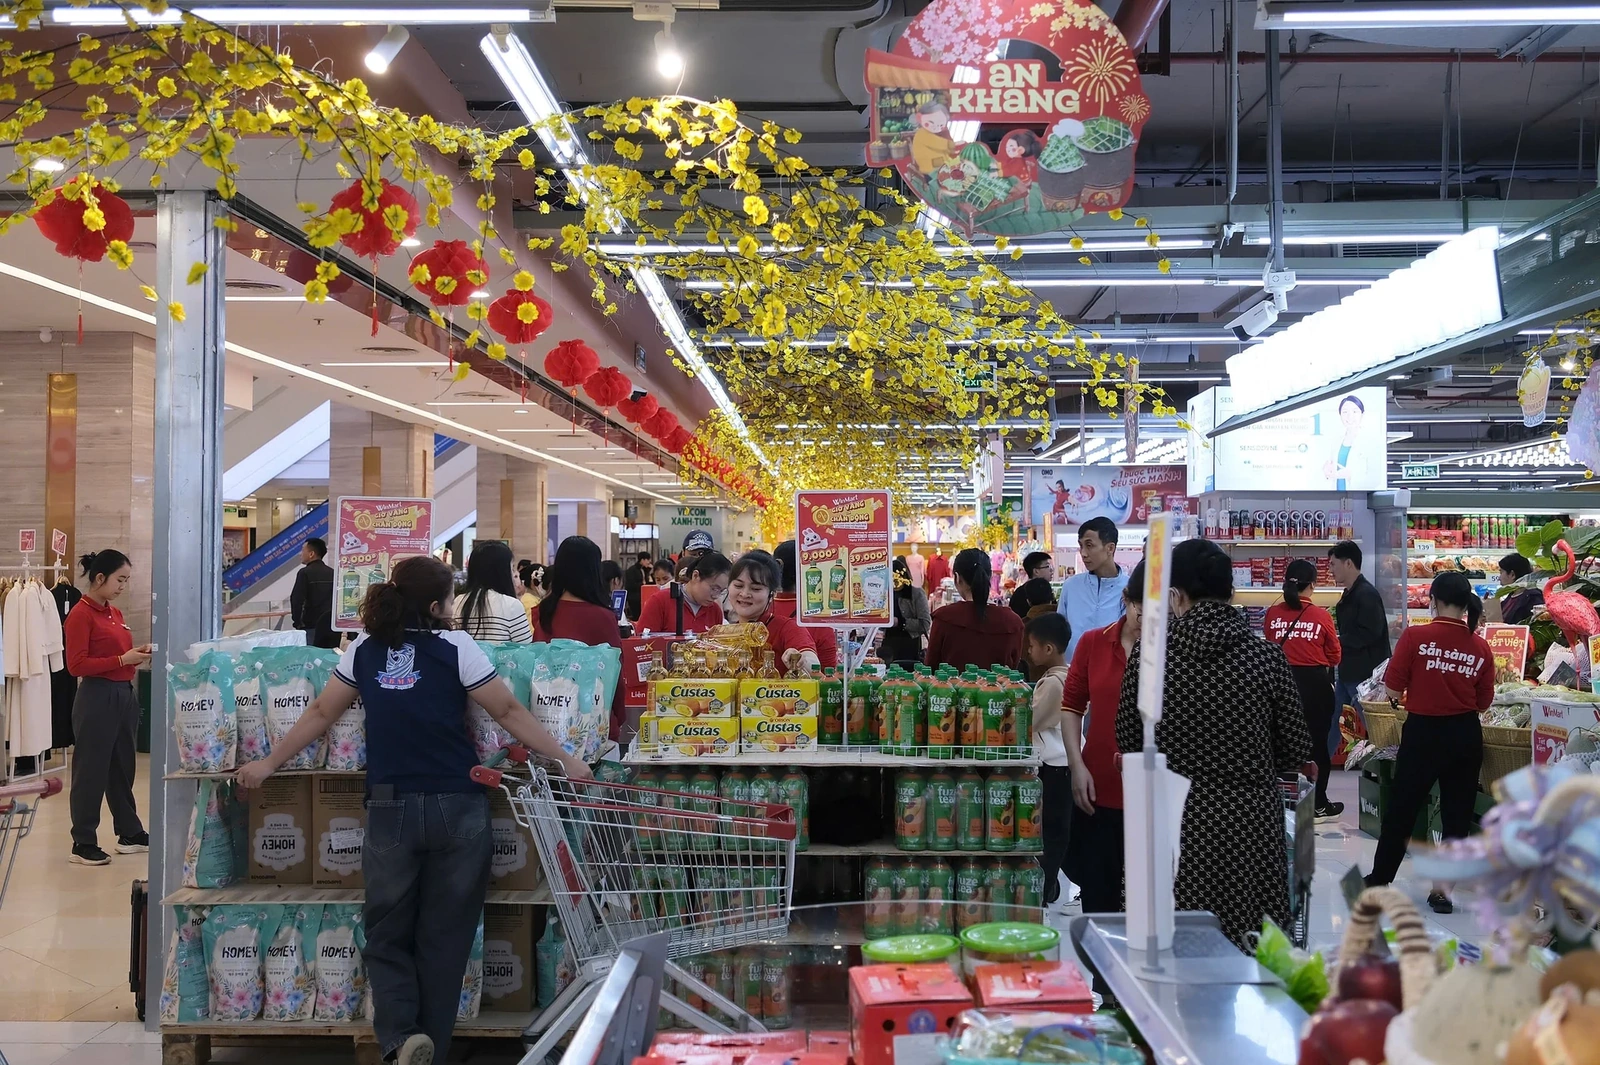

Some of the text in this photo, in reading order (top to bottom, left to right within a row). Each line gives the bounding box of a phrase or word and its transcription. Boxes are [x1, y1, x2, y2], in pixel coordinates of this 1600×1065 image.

[988, 64, 1040, 88] AN
[950, 89, 1080, 114] KHANG
[1270, 618, 1287, 629] Sẵn
[1419, 642, 1475, 665] Sẵn sàng
[1426, 658, 1456, 673] phục
[670, 686, 716, 698] Custas
[756, 686, 800, 699] Custas
[274, 696, 310, 708] HOMEY
[536, 694, 572, 708] HOMEY
[930, 695, 952, 705] fuze
[930, 704, 946, 712] tea
[674, 724, 720, 737] Custas
[756, 721, 802, 733] Custas
[988, 787, 1012, 798] fuze
[990, 797, 1007, 806] tea
[1019, 796, 1037, 804] tea
[261, 839, 295, 850] HOMEY
[222, 946, 258, 958] HOMEY
[267, 946, 297, 957] HOMEY
[321, 946, 356, 958] HOMEY
